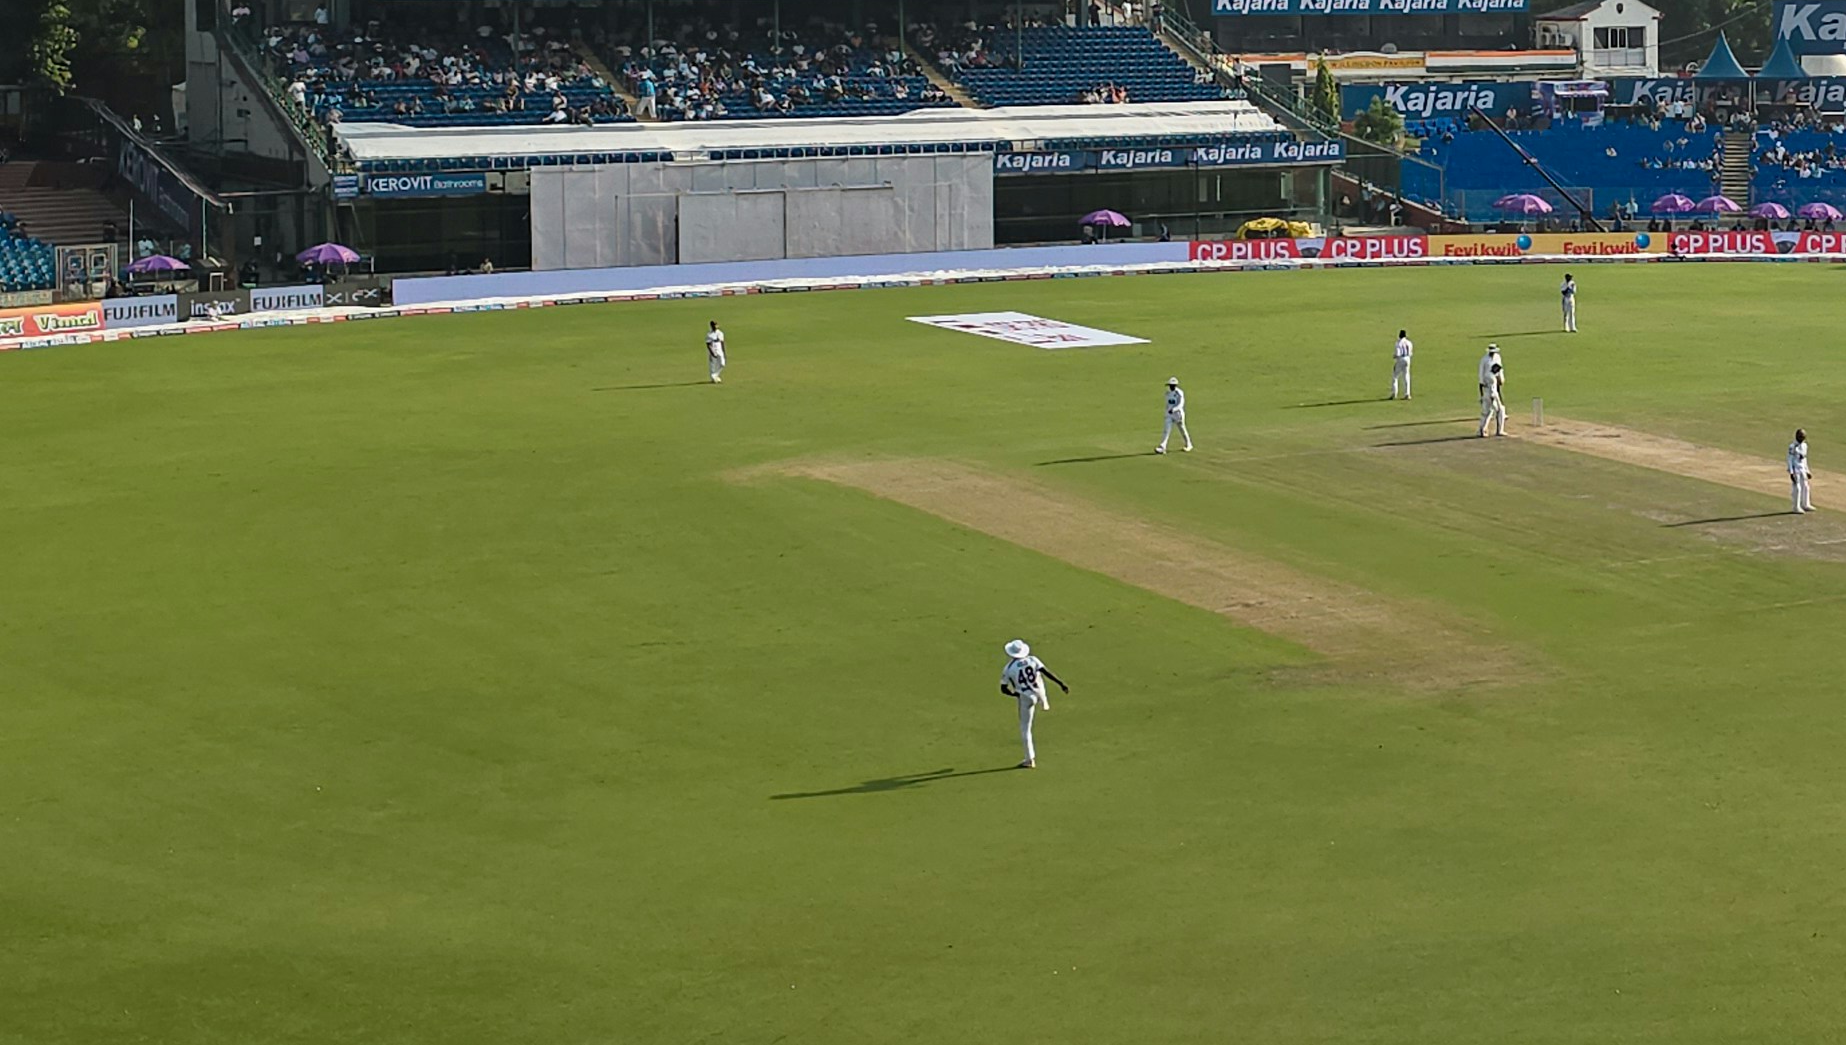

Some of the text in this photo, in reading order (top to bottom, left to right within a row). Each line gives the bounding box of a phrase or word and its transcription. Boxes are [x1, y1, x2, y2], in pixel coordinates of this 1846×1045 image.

[1385, 84, 1495, 118] Kajaria
[1101, 149, 1172, 167] Kajaria
[1197, 144, 1262, 163] Kajaria
[1273, 140, 1340, 158] Kajaria
[997, 152, 1070, 172] Kajaria
[368, 176, 432, 192] KEROVIT
[1197, 242, 1289, 260] CP PLUS
[1331, 238, 1422, 258] CP PLUS
[1674, 234, 1765, 253] CP PLUS
[1806, 234, 1836, 253] CP
[190, 299, 236, 316] insax
[253, 294, 322, 310] FUJIFILM
[104, 303, 175, 322] FUJIFILM
